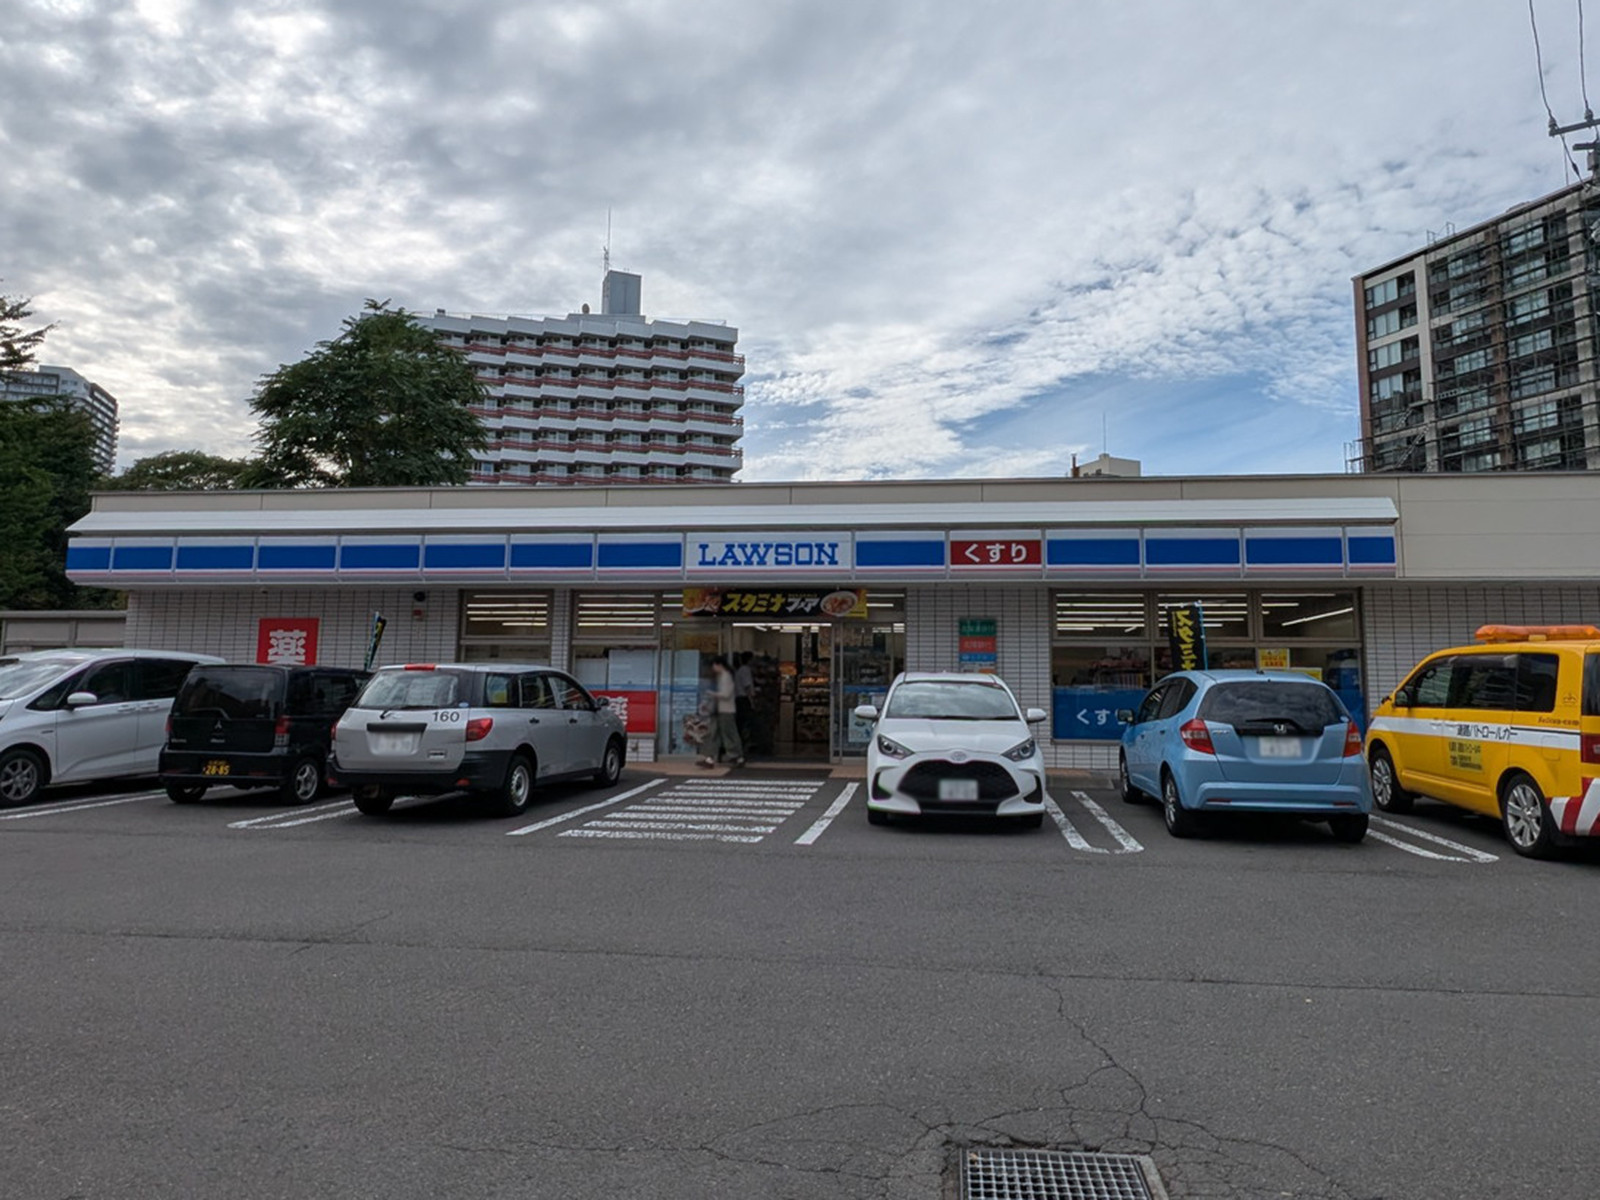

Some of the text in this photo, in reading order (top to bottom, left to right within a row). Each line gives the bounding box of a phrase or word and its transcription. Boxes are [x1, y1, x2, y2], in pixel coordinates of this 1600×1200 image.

[698, 543, 839, 566] LAWSON
[964, 543, 1027, 562] くすり
[267, 629, 307, 666] 薬
[432, 711, 460, 723] 160
